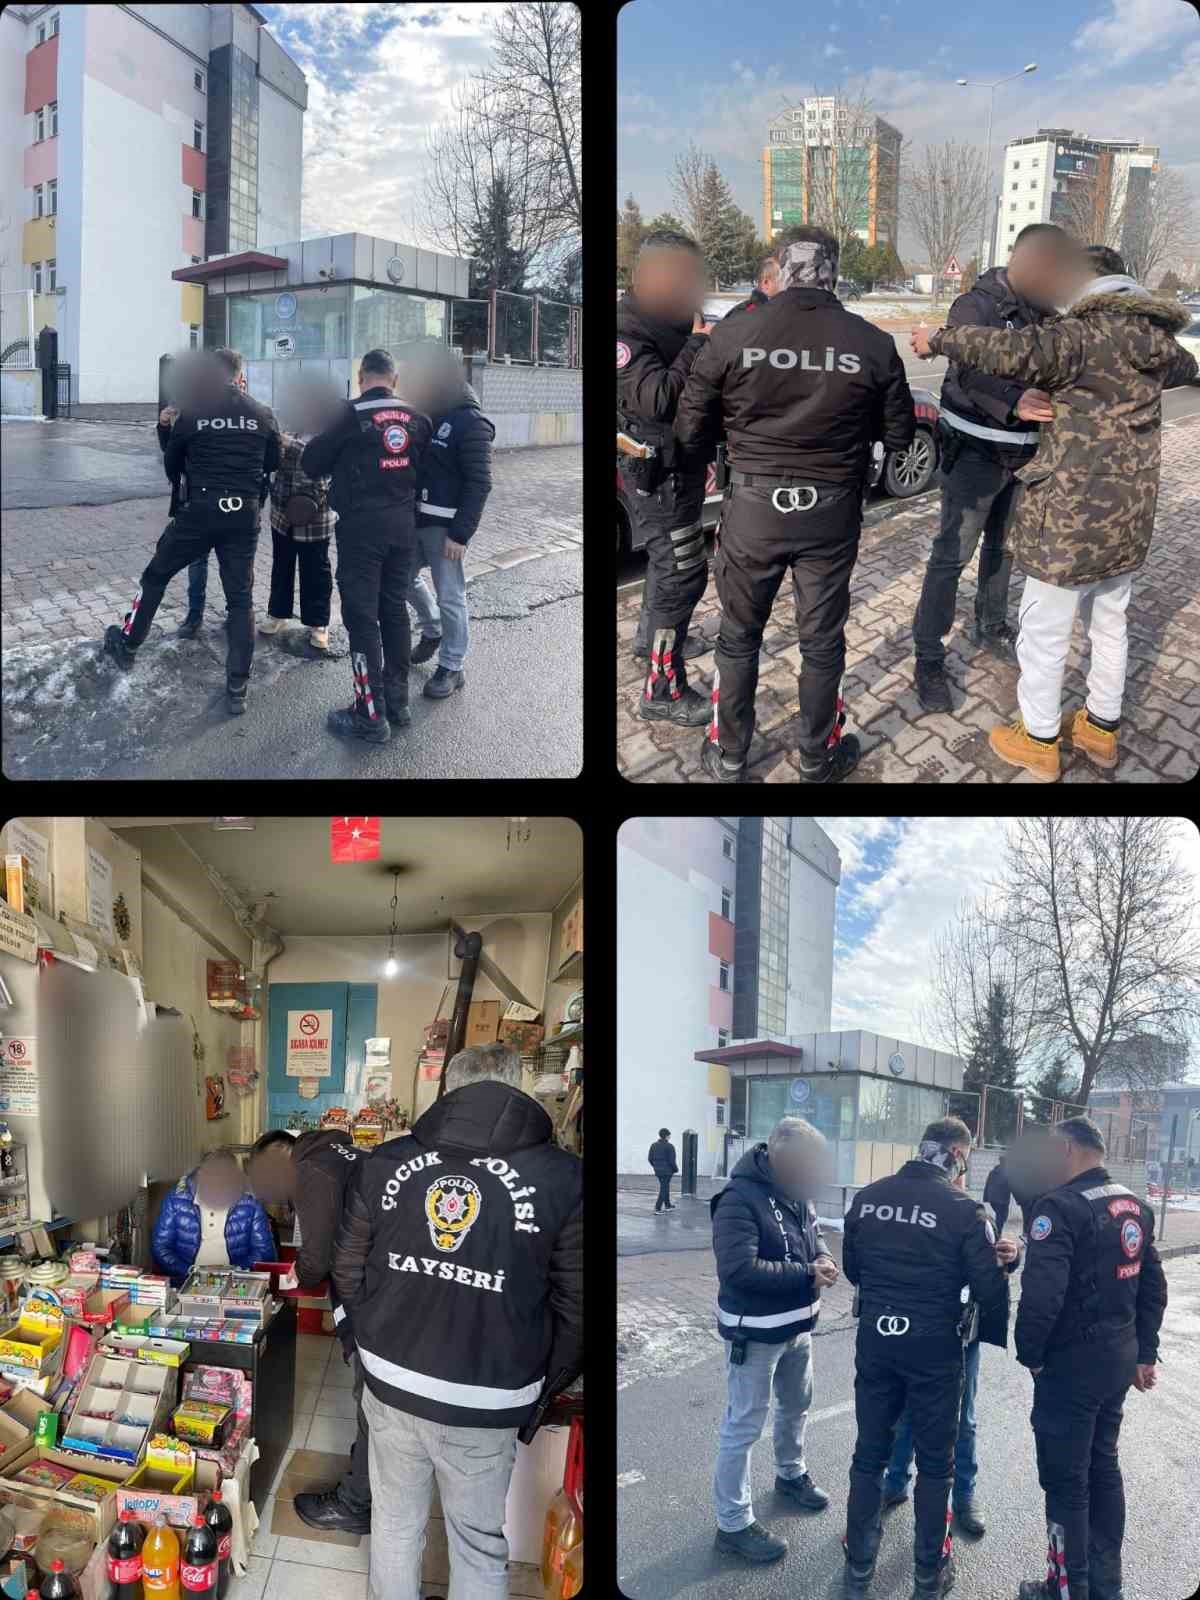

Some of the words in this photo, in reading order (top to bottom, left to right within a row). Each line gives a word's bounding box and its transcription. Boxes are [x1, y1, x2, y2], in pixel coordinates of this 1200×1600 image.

[742, 347, 861, 374] POLİS
[197, 416, 258, 431] POLİS
[382, 1151, 443, 1211] ÇOCUK
[439, 1178, 474, 1192] POLİS
[859, 1203, 937, 1229] POLİS
[388, 1252, 506, 1293] KAYSERİ
